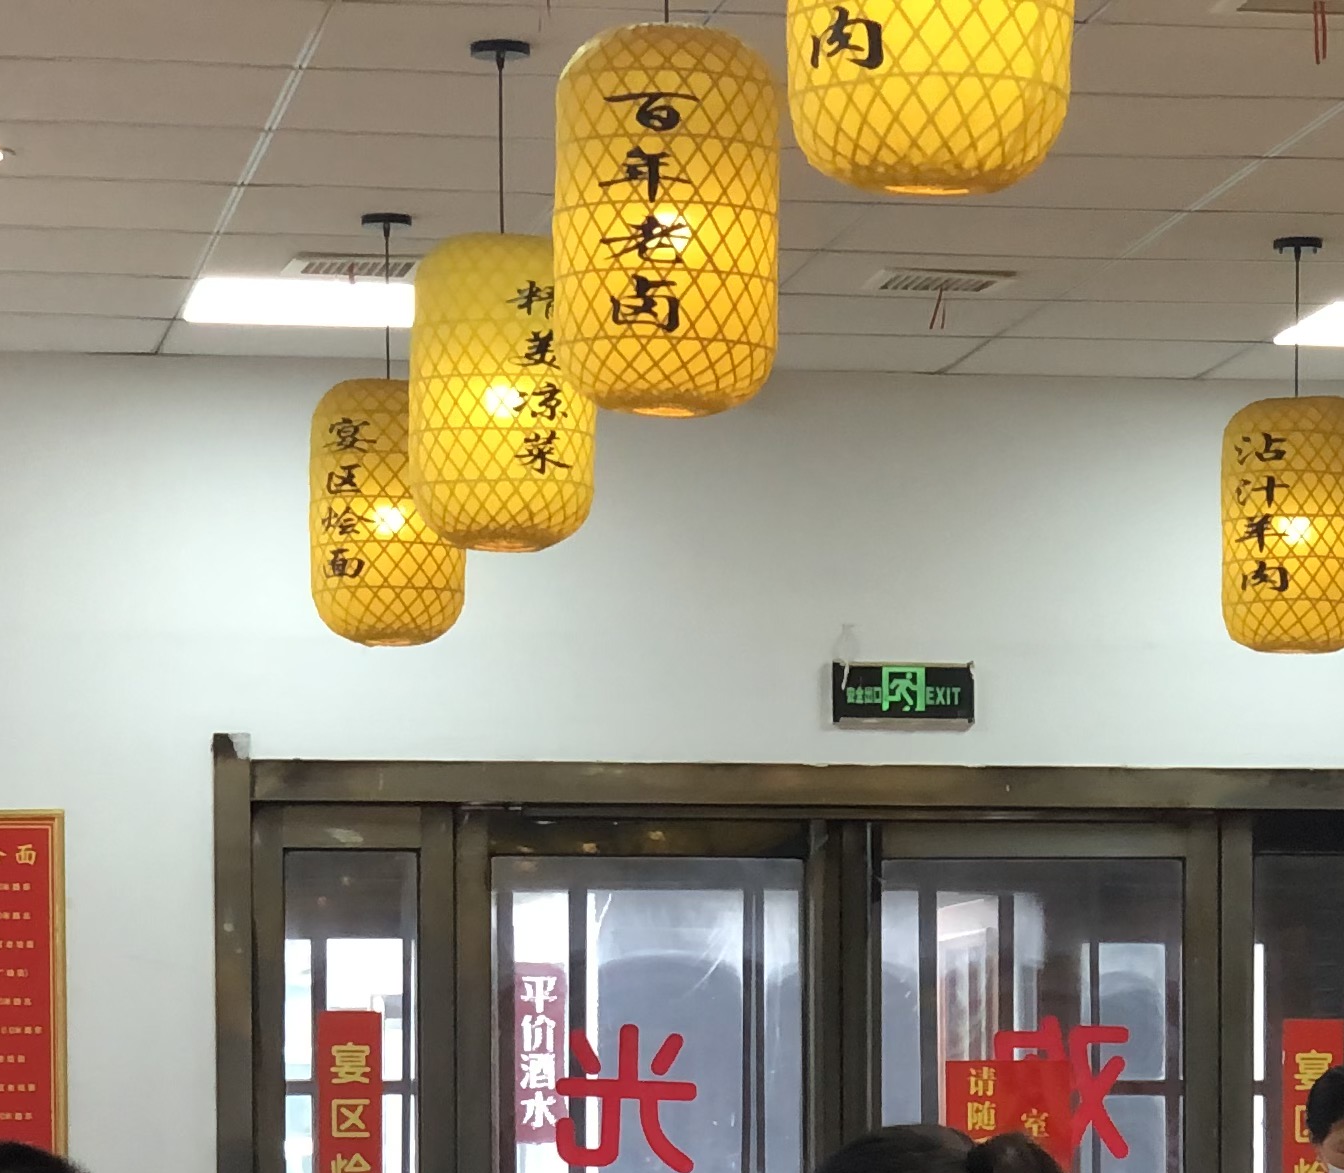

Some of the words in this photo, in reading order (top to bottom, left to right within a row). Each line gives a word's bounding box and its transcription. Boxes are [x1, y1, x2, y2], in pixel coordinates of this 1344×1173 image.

[810, 5, 884, 70] 肉
[599, 91, 700, 334] 百年老卤
[506, 280, 572, 475] 精美凉菜
[321, 417, 378, 579] 宴区烩面
[1234, 432, 1290, 592] 沾汁羊肉
[925, 687, 961, 706] EXIT
[520, 975, 557, 1129] 平价酒水
[967, 1066, 998, 1144] 请随
[1020, 1108, 1050, 1138] 室
